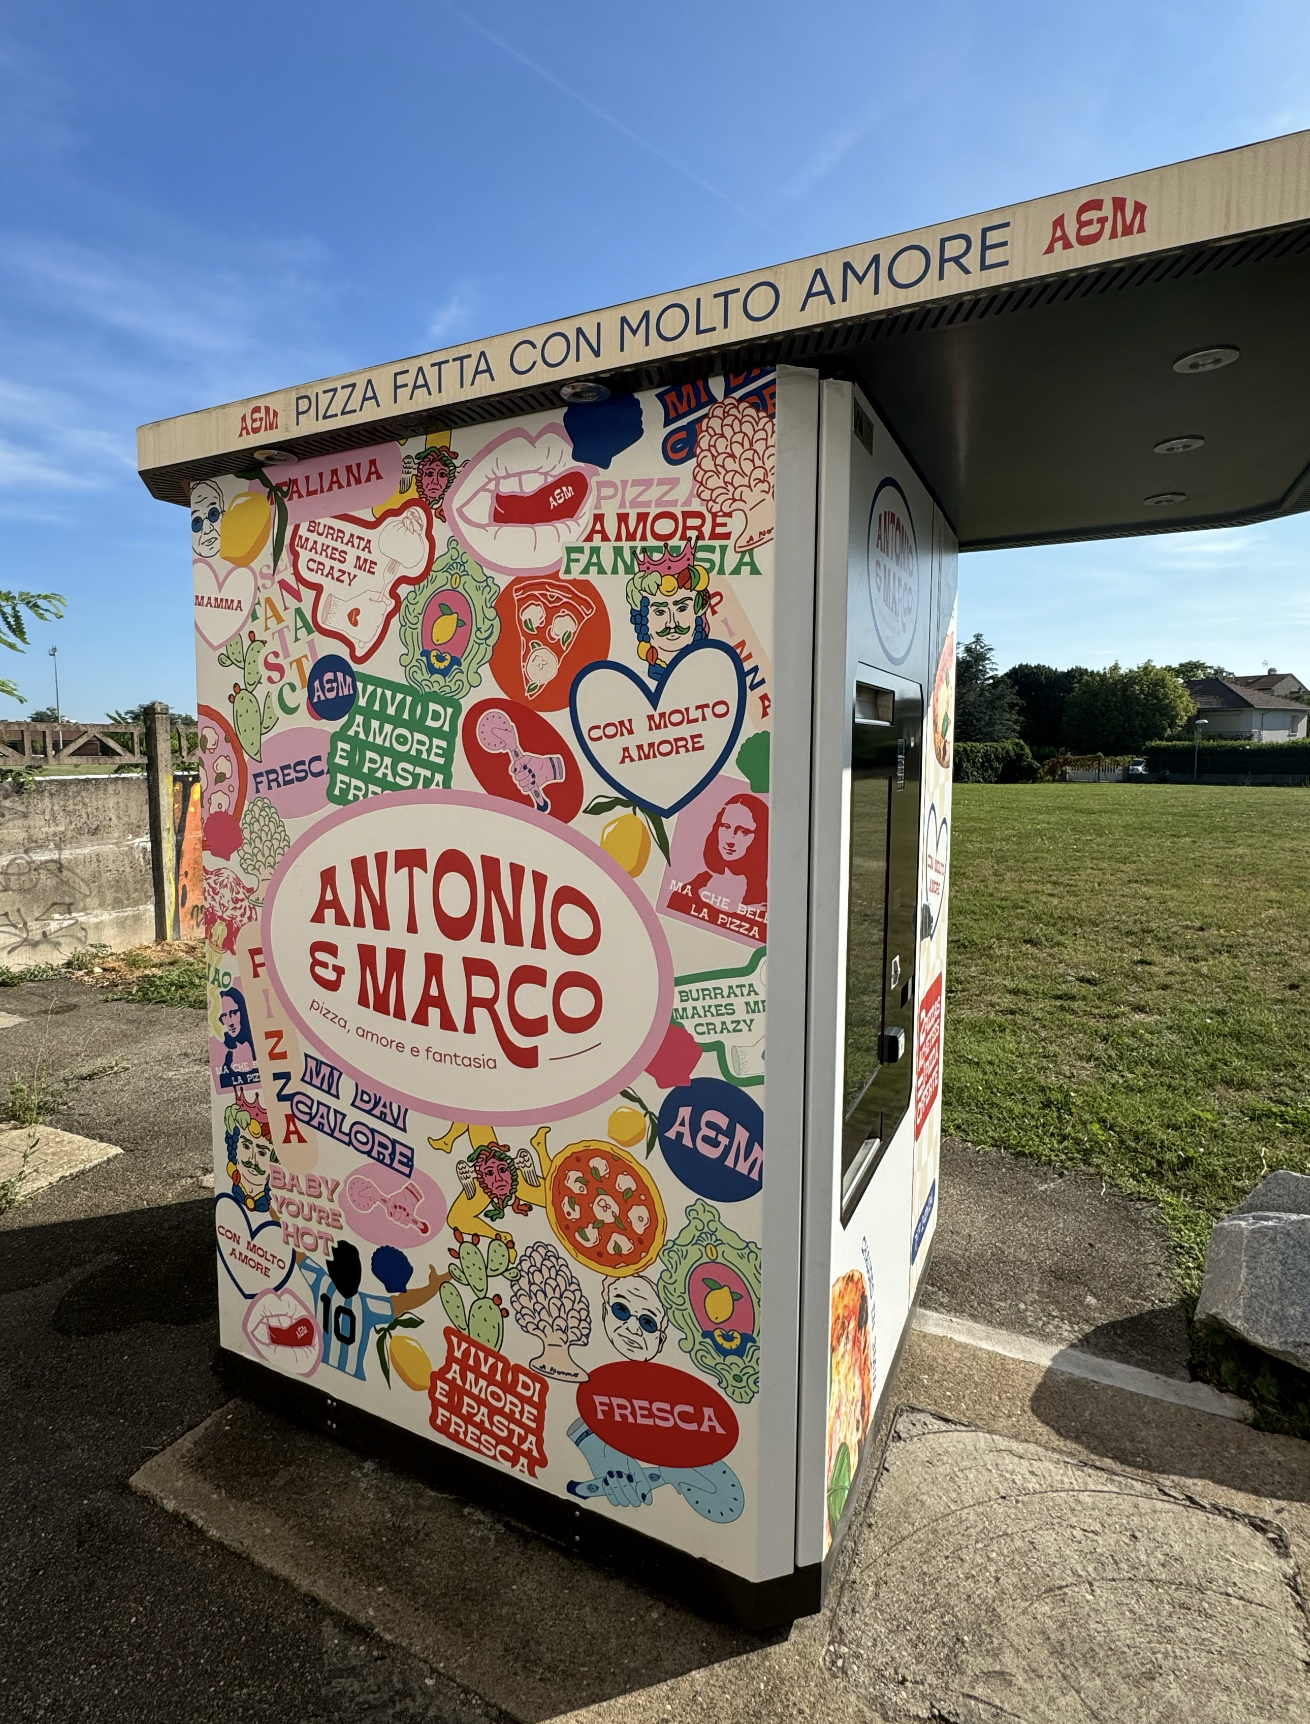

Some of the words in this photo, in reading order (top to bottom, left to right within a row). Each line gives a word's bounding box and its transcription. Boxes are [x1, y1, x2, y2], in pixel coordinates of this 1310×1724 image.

[237, 404, 279, 438] A&M
[295, 378, 381, 426] PIZZA
[393, 350, 495, 404] FATTA
[509, 321, 601, 375] CON
[619, 281, 780, 352] MOLTO
[799, 221, 1011, 312] AMORE
[1042, 196, 1148, 256] A&M
[549, 486, 575, 510] A&M
[307, 520, 372, 554] BURRATA
[582, 510, 733, 542] AMORE
[296, 534, 347, 565] MAKES
[353, 555, 377, 576] ME
[306, 557, 358, 587] CRAZY
[194, 594, 243, 612] MAMMA
[312, 671, 354, 703] A&M
[356, 681, 413, 720] VIVI
[424, 702, 454, 732] DI
[346, 714, 447, 765] AMORE
[587, 718, 634, 742] CON
[646, 700, 730, 732] MOLTO
[334, 740, 351, 766] E
[362, 749, 444, 789] PASTA
[618, 733, 705, 765] AMORE
[252, 751, 331, 794] FRESC
[309, 848, 602, 956] ANTONIO
[669, 879, 693, 897] MA
[700, 890, 731, 910] CHE
[736, 903, 768, 924] BELL
[690, 903, 710, 921] LA
[717, 913, 760, 939] PIZZA
[309, 940, 346, 992] &
[356, 943, 603, 1069] MARCO
[673, 1002, 736, 1021] MAKES
[677, 982, 760, 1003] BURRATA
[309, 998, 350, 1034] pizza,
[355, 1026, 405, 1053] amore
[410, 1045, 421, 1057] e
[425, 1046, 497, 1070] fantasia
[693, 1018, 755, 1036] CRAZY
[231, 1075, 244, 1085] LA
[232, 1062, 249, 1071] CHE
[302, 1053, 343, 1099] MI
[291, 1092, 414, 1178] CALORE
[664, 1106, 764, 1182] A&M
[269, 1163, 340, 1203] BABY
[271, 1192, 343, 1230] YOU'RE
[217, 1225, 241, 1246] CON
[246, 1240, 286, 1271] MOLTO
[281, 1220, 334, 1257] HOT
[228, 1247, 271, 1278] AMORE
[319, 1292, 356, 1345] 10
[450, 1335, 503, 1382] VIVI
[516, 1372, 541, 1402] DI
[445, 1362, 538, 1428] AMORE
[592, 1394, 727, 1435] FRESCA
[434, 1380, 450, 1404] E
[461, 1395, 540, 1459] PASTA
[435, 1406, 538, 1479] FRESCA
